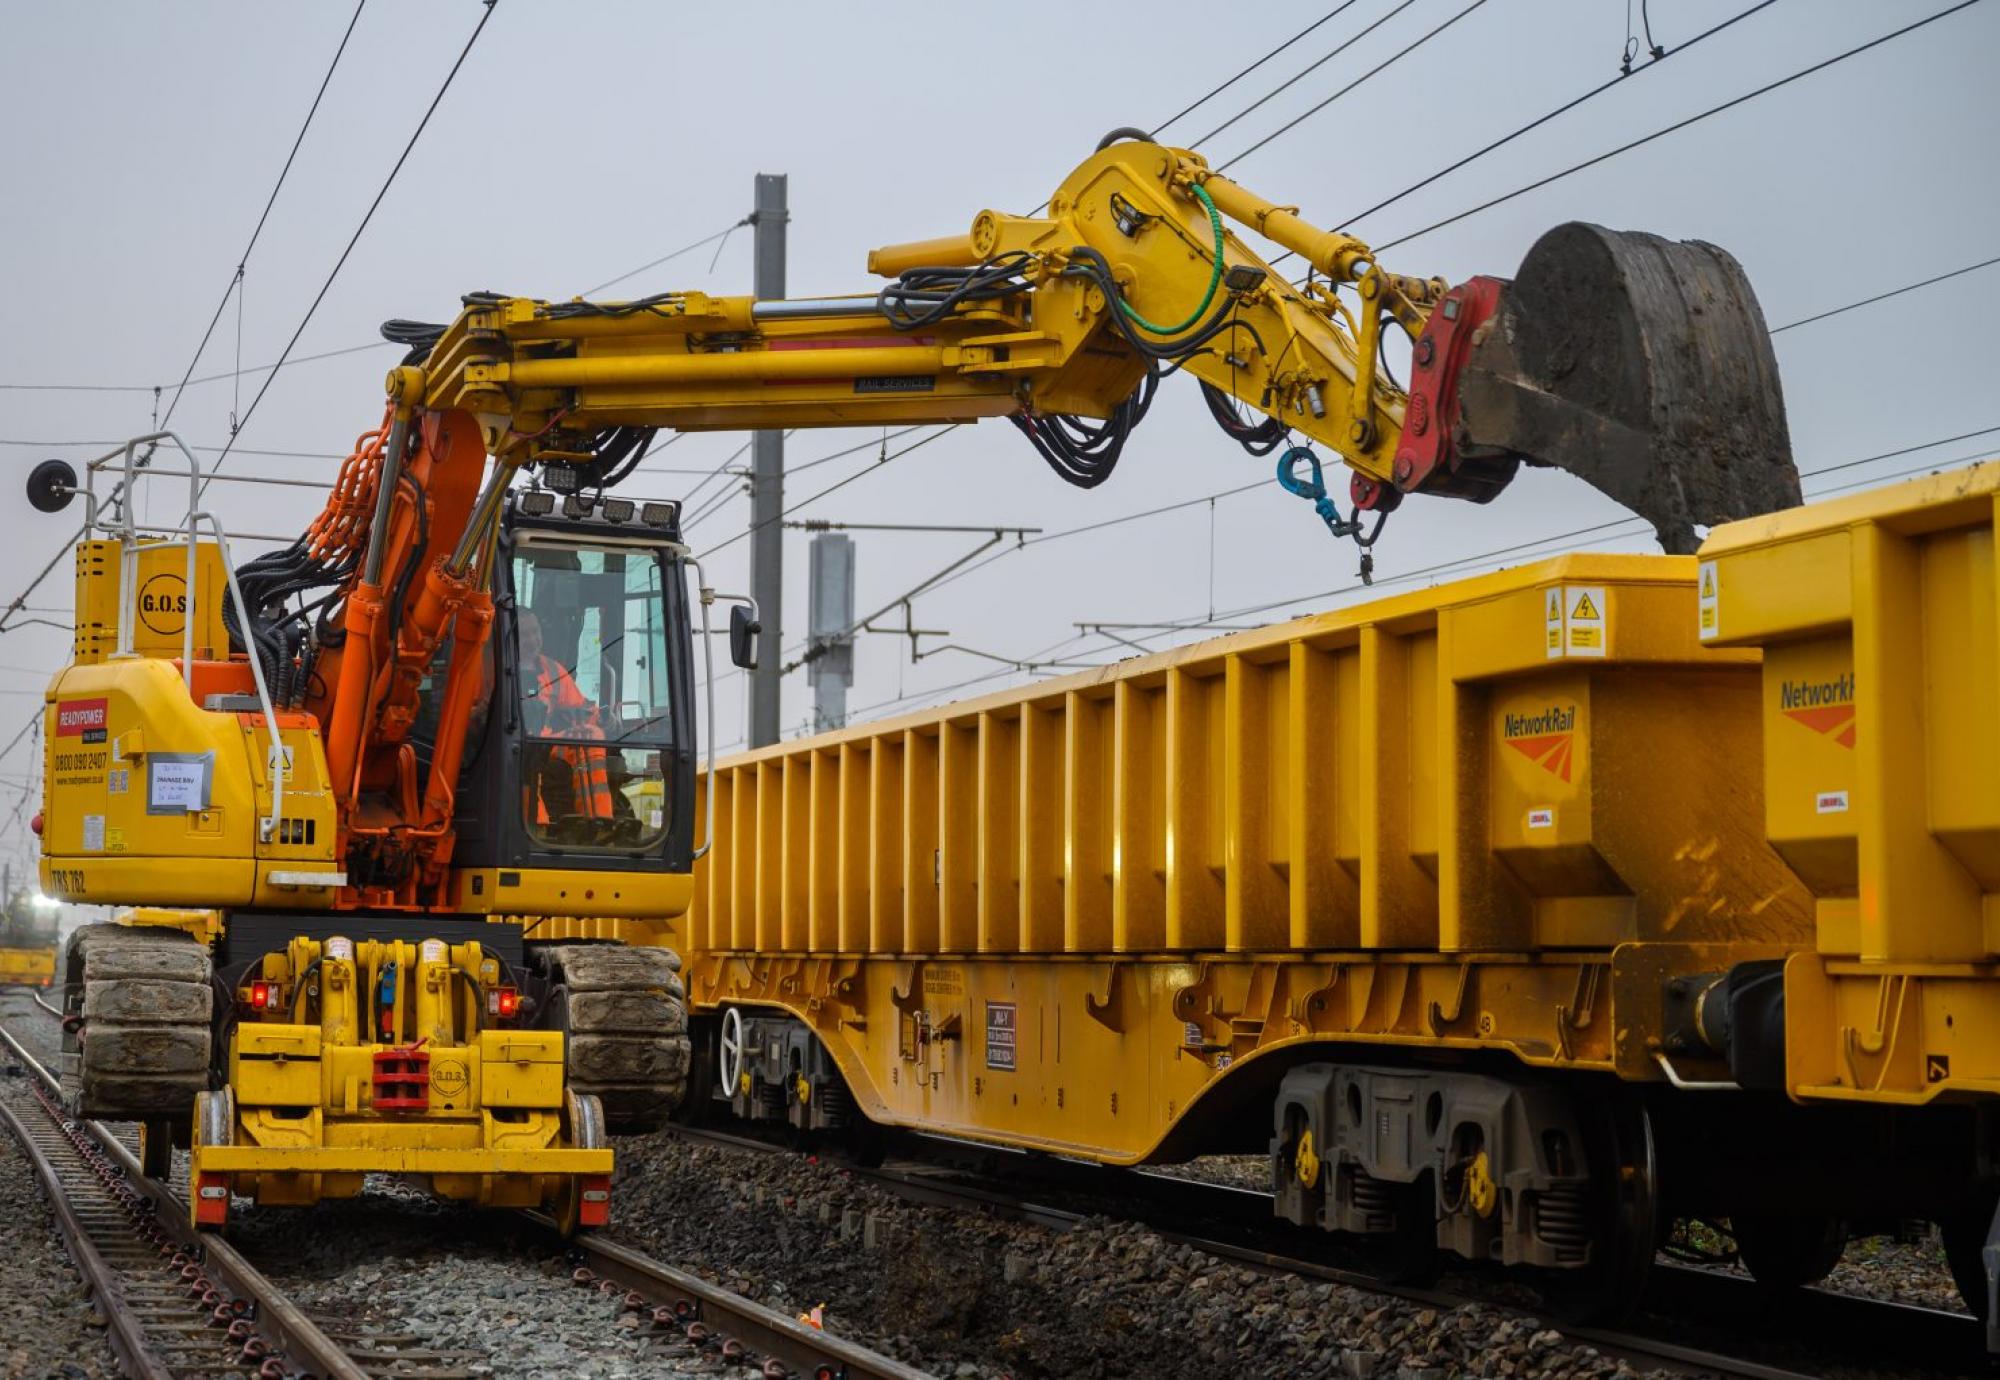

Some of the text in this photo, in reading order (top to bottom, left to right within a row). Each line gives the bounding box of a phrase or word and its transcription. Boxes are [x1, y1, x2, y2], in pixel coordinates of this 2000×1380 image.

[59, 709, 105, 726] READYPOWER
[55, 751, 107, 772] 0800 090 2407
[52, 869, 87, 894] TRS 762
